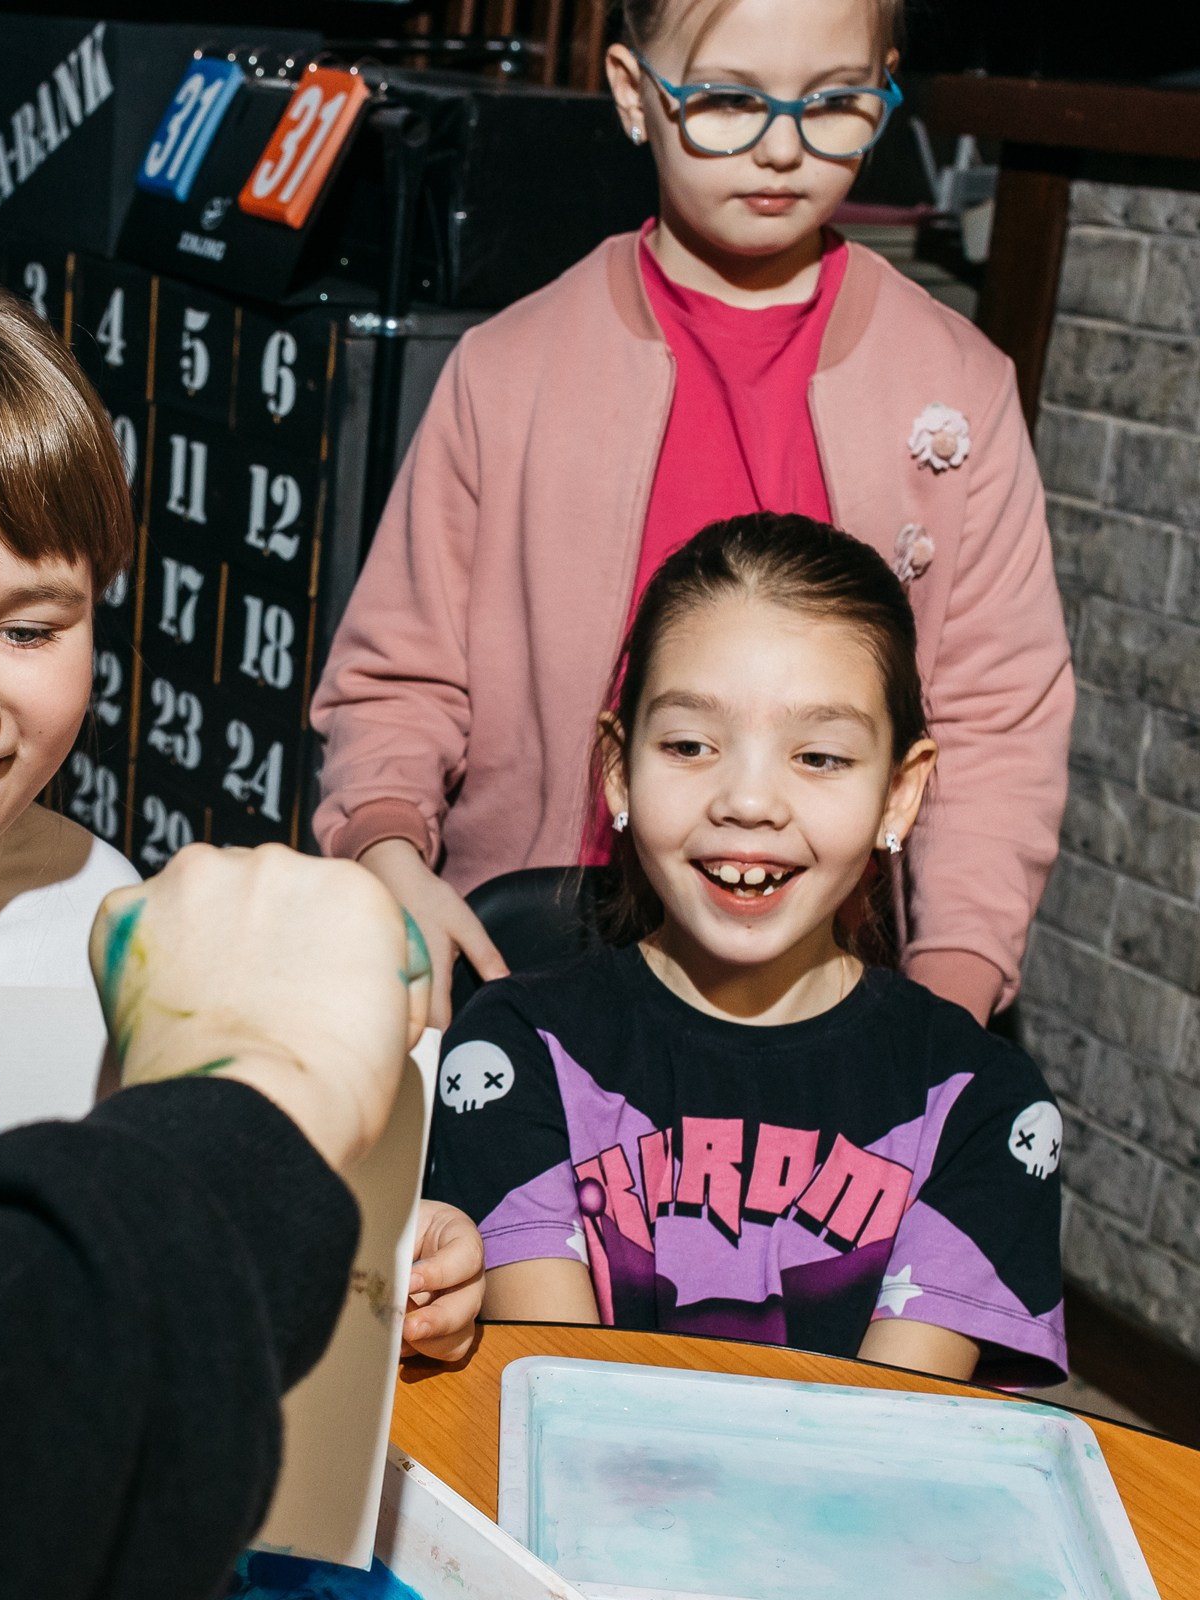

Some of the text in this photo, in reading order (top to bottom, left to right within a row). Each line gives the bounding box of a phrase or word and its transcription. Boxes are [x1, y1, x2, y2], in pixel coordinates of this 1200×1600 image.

[145, 73, 224, 181] 31
[252, 86, 347, 203] 31
[96, 287, 127, 366] 4
[180, 308, 210, 390] 5
[261, 331, 298, 417] 6
[166, 434, 208, 524] 11
[245, 465, 301, 561] 12
[160, 557, 204, 644] 17
[240, 595, 295, 690] 18
[69, 751, 119, 839] 28
[148, 677, 202, 770] 23
[222, 719, 283, 823] 24
